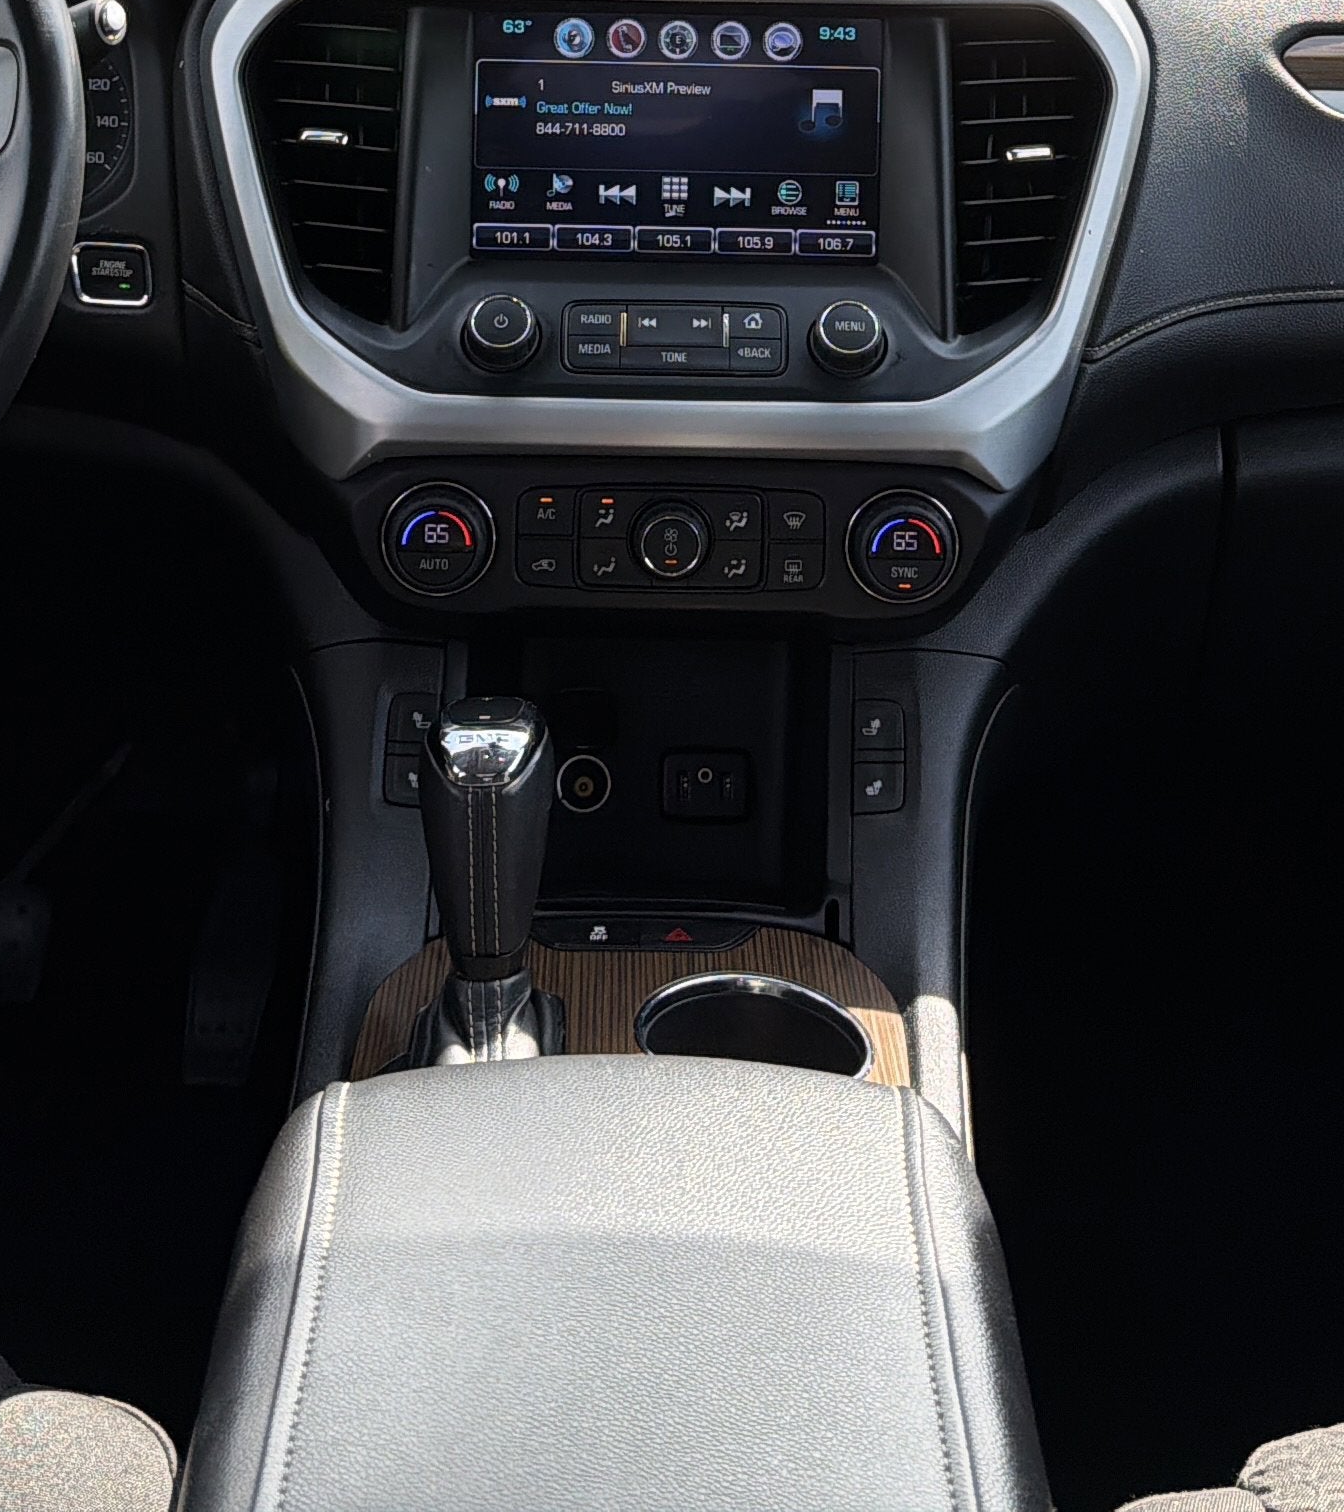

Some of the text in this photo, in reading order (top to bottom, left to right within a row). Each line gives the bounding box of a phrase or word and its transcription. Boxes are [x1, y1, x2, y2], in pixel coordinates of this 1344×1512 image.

[818, 26, 857, 41] 9:43
[88, 78, 110, 91] 120
[537, 79, 545, 91] 1
[612, 81, 711, 96] SiriusXM Preview
[537, 102, 632, 116] Great Offer Now!
[96, 115, 119, 128] 140
[536, 123, 626, 136] 844-711-8800
[86, 152, 105, 164] 60
[489, 200, 515, 210] RADIO
[546, 201, 573, 211] MEDIA
[771, 206, 808, 216] BROWSE
[834, 207, 859, 217] MENU
[494, 231, 530, 245] 101.1
[575, 233, 612, 247] 104.3
[656, 234, 691, 248] 105.1
[737, 236, 774, 250] 105.9
[817, 237, 854, 252] 106.7
[99, 259, 126, 269] ENGINE
[580, 314, 612, 326] RADIO
[834, 319, 866, 332] MENU
[578, 343, 611, 356] MEDIA
[744, 347, 772, 360] BACK
[660, 351, 688, 364] TONE
[537, 506, 556, 521] A/C
[424, 524, 450, 544] 65
[893, 531, 919, 551] 65
[419, 557, 450, 572] AUTO
[782, 573, 804, 584] REAR
[890, 565, 919, 580] SYNC
